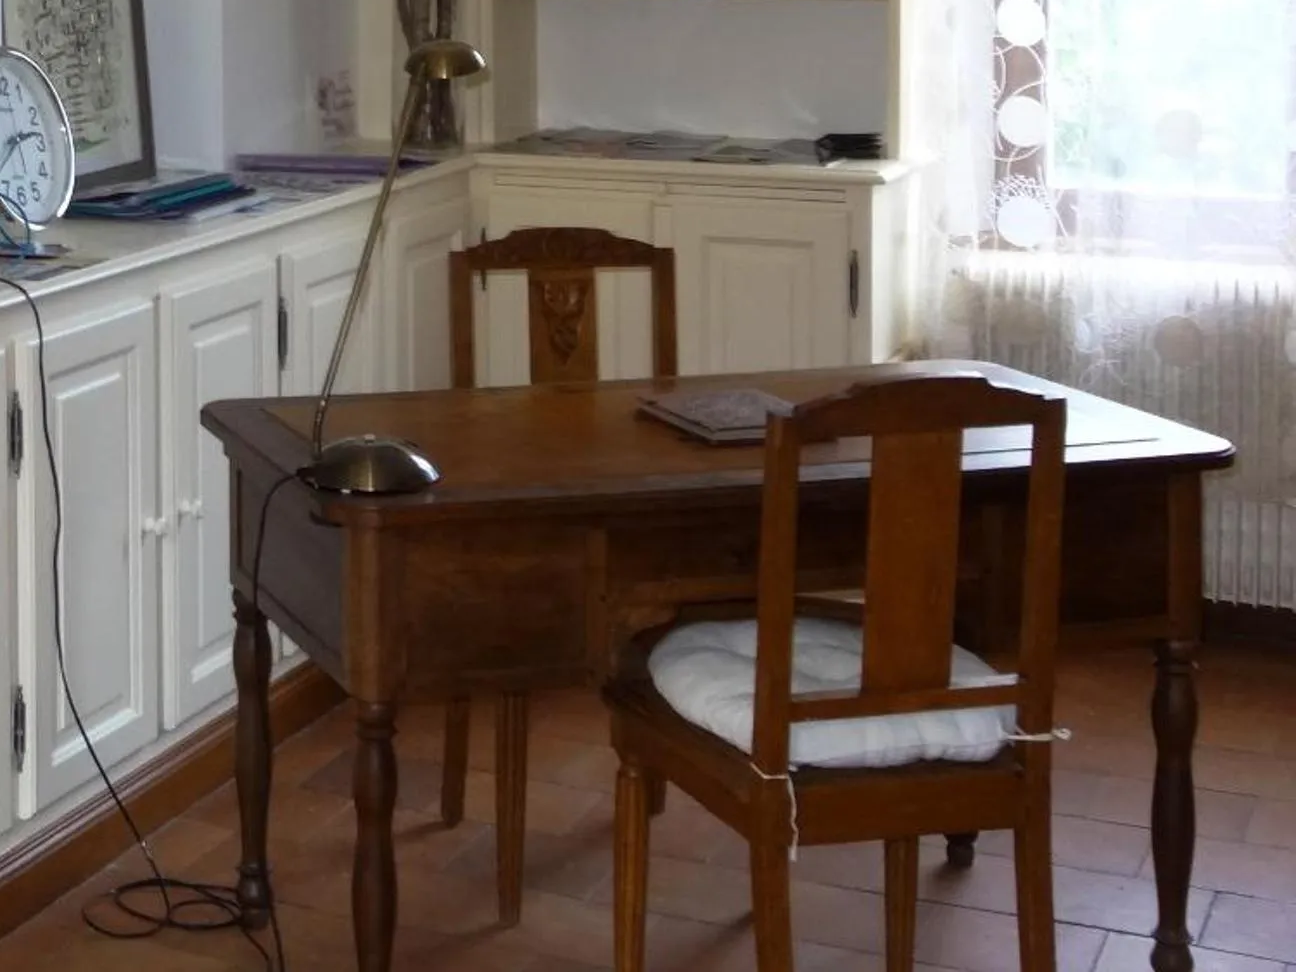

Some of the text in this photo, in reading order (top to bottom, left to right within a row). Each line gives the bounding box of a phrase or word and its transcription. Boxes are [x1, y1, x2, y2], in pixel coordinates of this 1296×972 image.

[15, 85, 23, 103] 1
[28, 106, 39, 126] 2
[35, 134, 46, 152] 3
[38, 161, 48, 178] 4
[1, 180, 10, 197] 7
[16, 186, 27, 205] 6
[30, 182, 40, 201] 5
